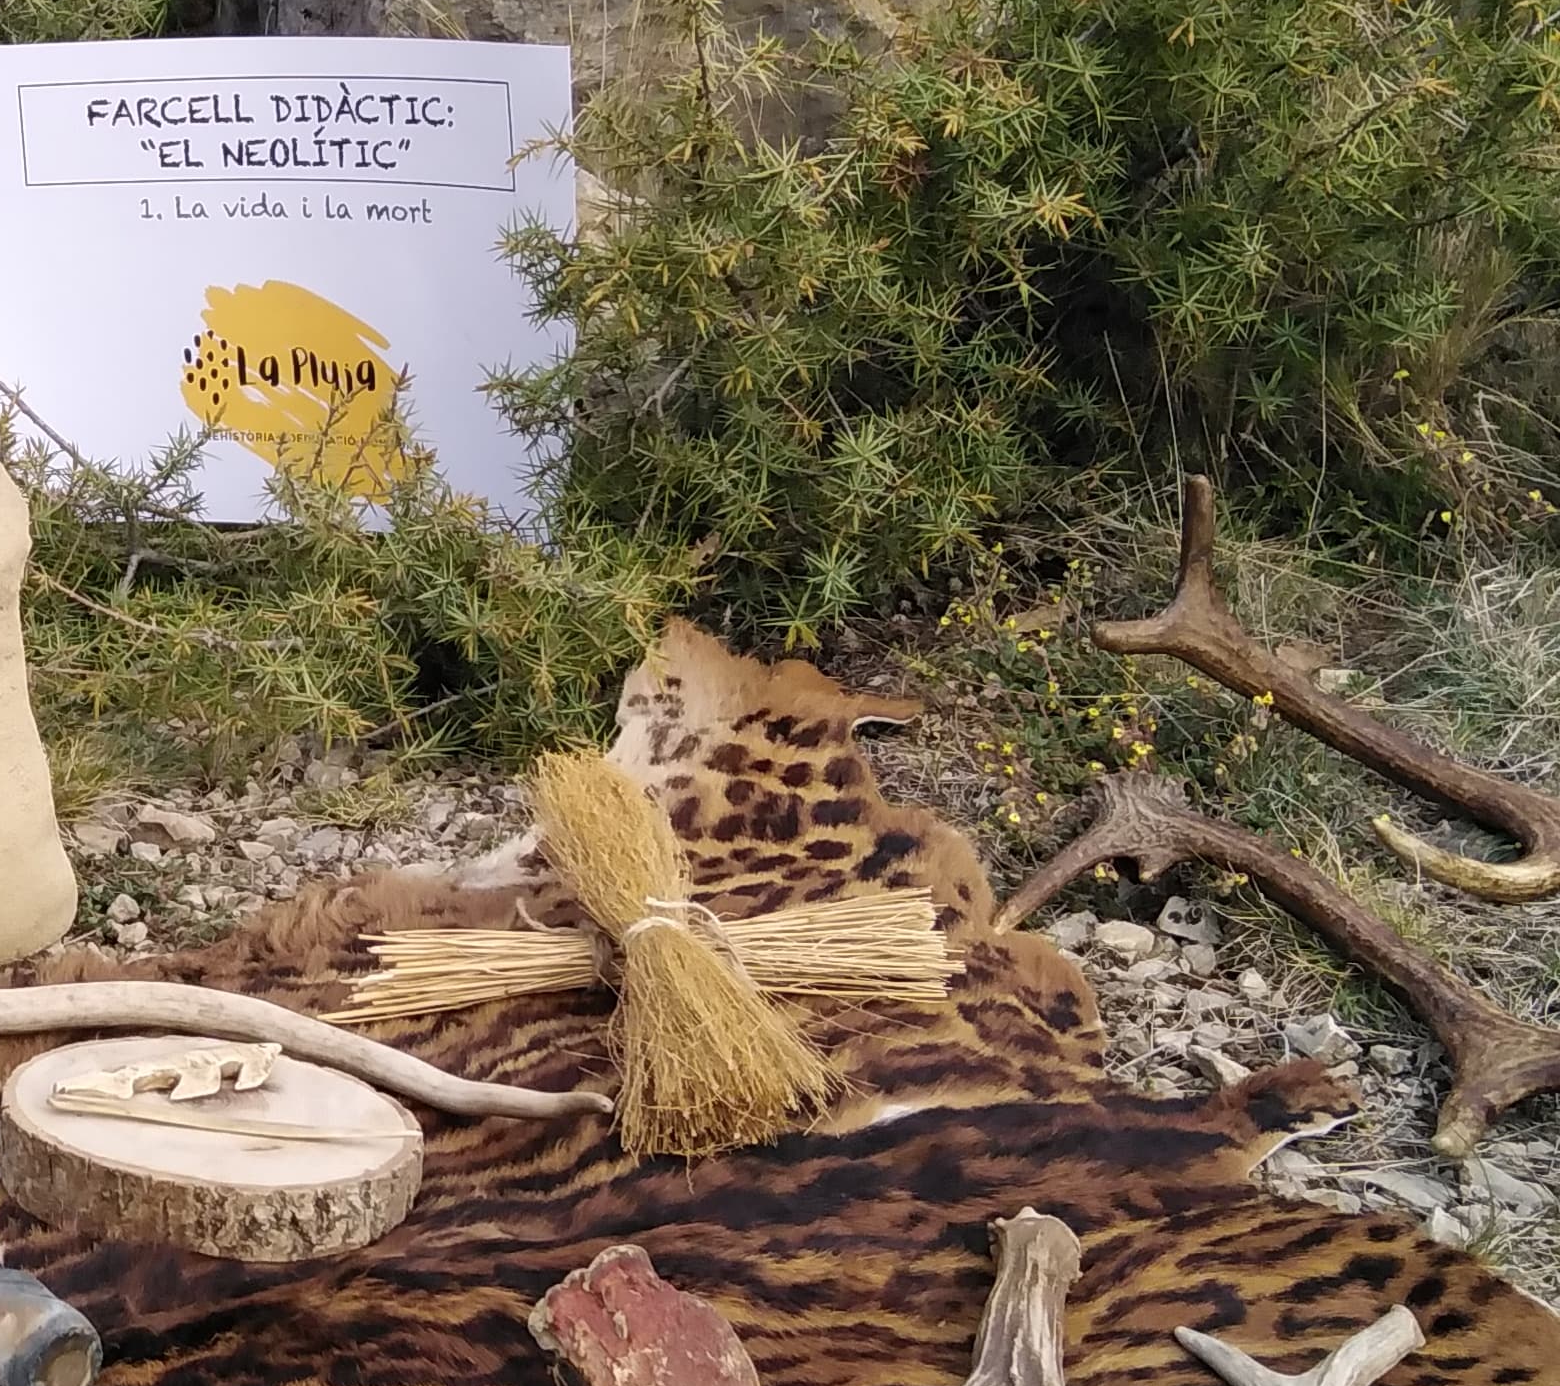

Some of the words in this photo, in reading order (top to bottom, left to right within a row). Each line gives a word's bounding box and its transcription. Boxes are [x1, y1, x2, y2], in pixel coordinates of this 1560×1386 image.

[87, 93, 255, 128] FARCELL
[270, 82, 455, 128] DIDÀCTIC:
[140, 198, 162, 220] 1.
[176, 195, 209, 220] La
[223, 191, 289, 219] vida
[302, 196, 314, 219] i
[325, 194, 353, 220] la
[366, 198, 433, 224] mort
[237, 345, 280, 387] La
[291, 346, 376, 397] Pluja
[197, 429, 275, 443] PEHISTÒRIA
